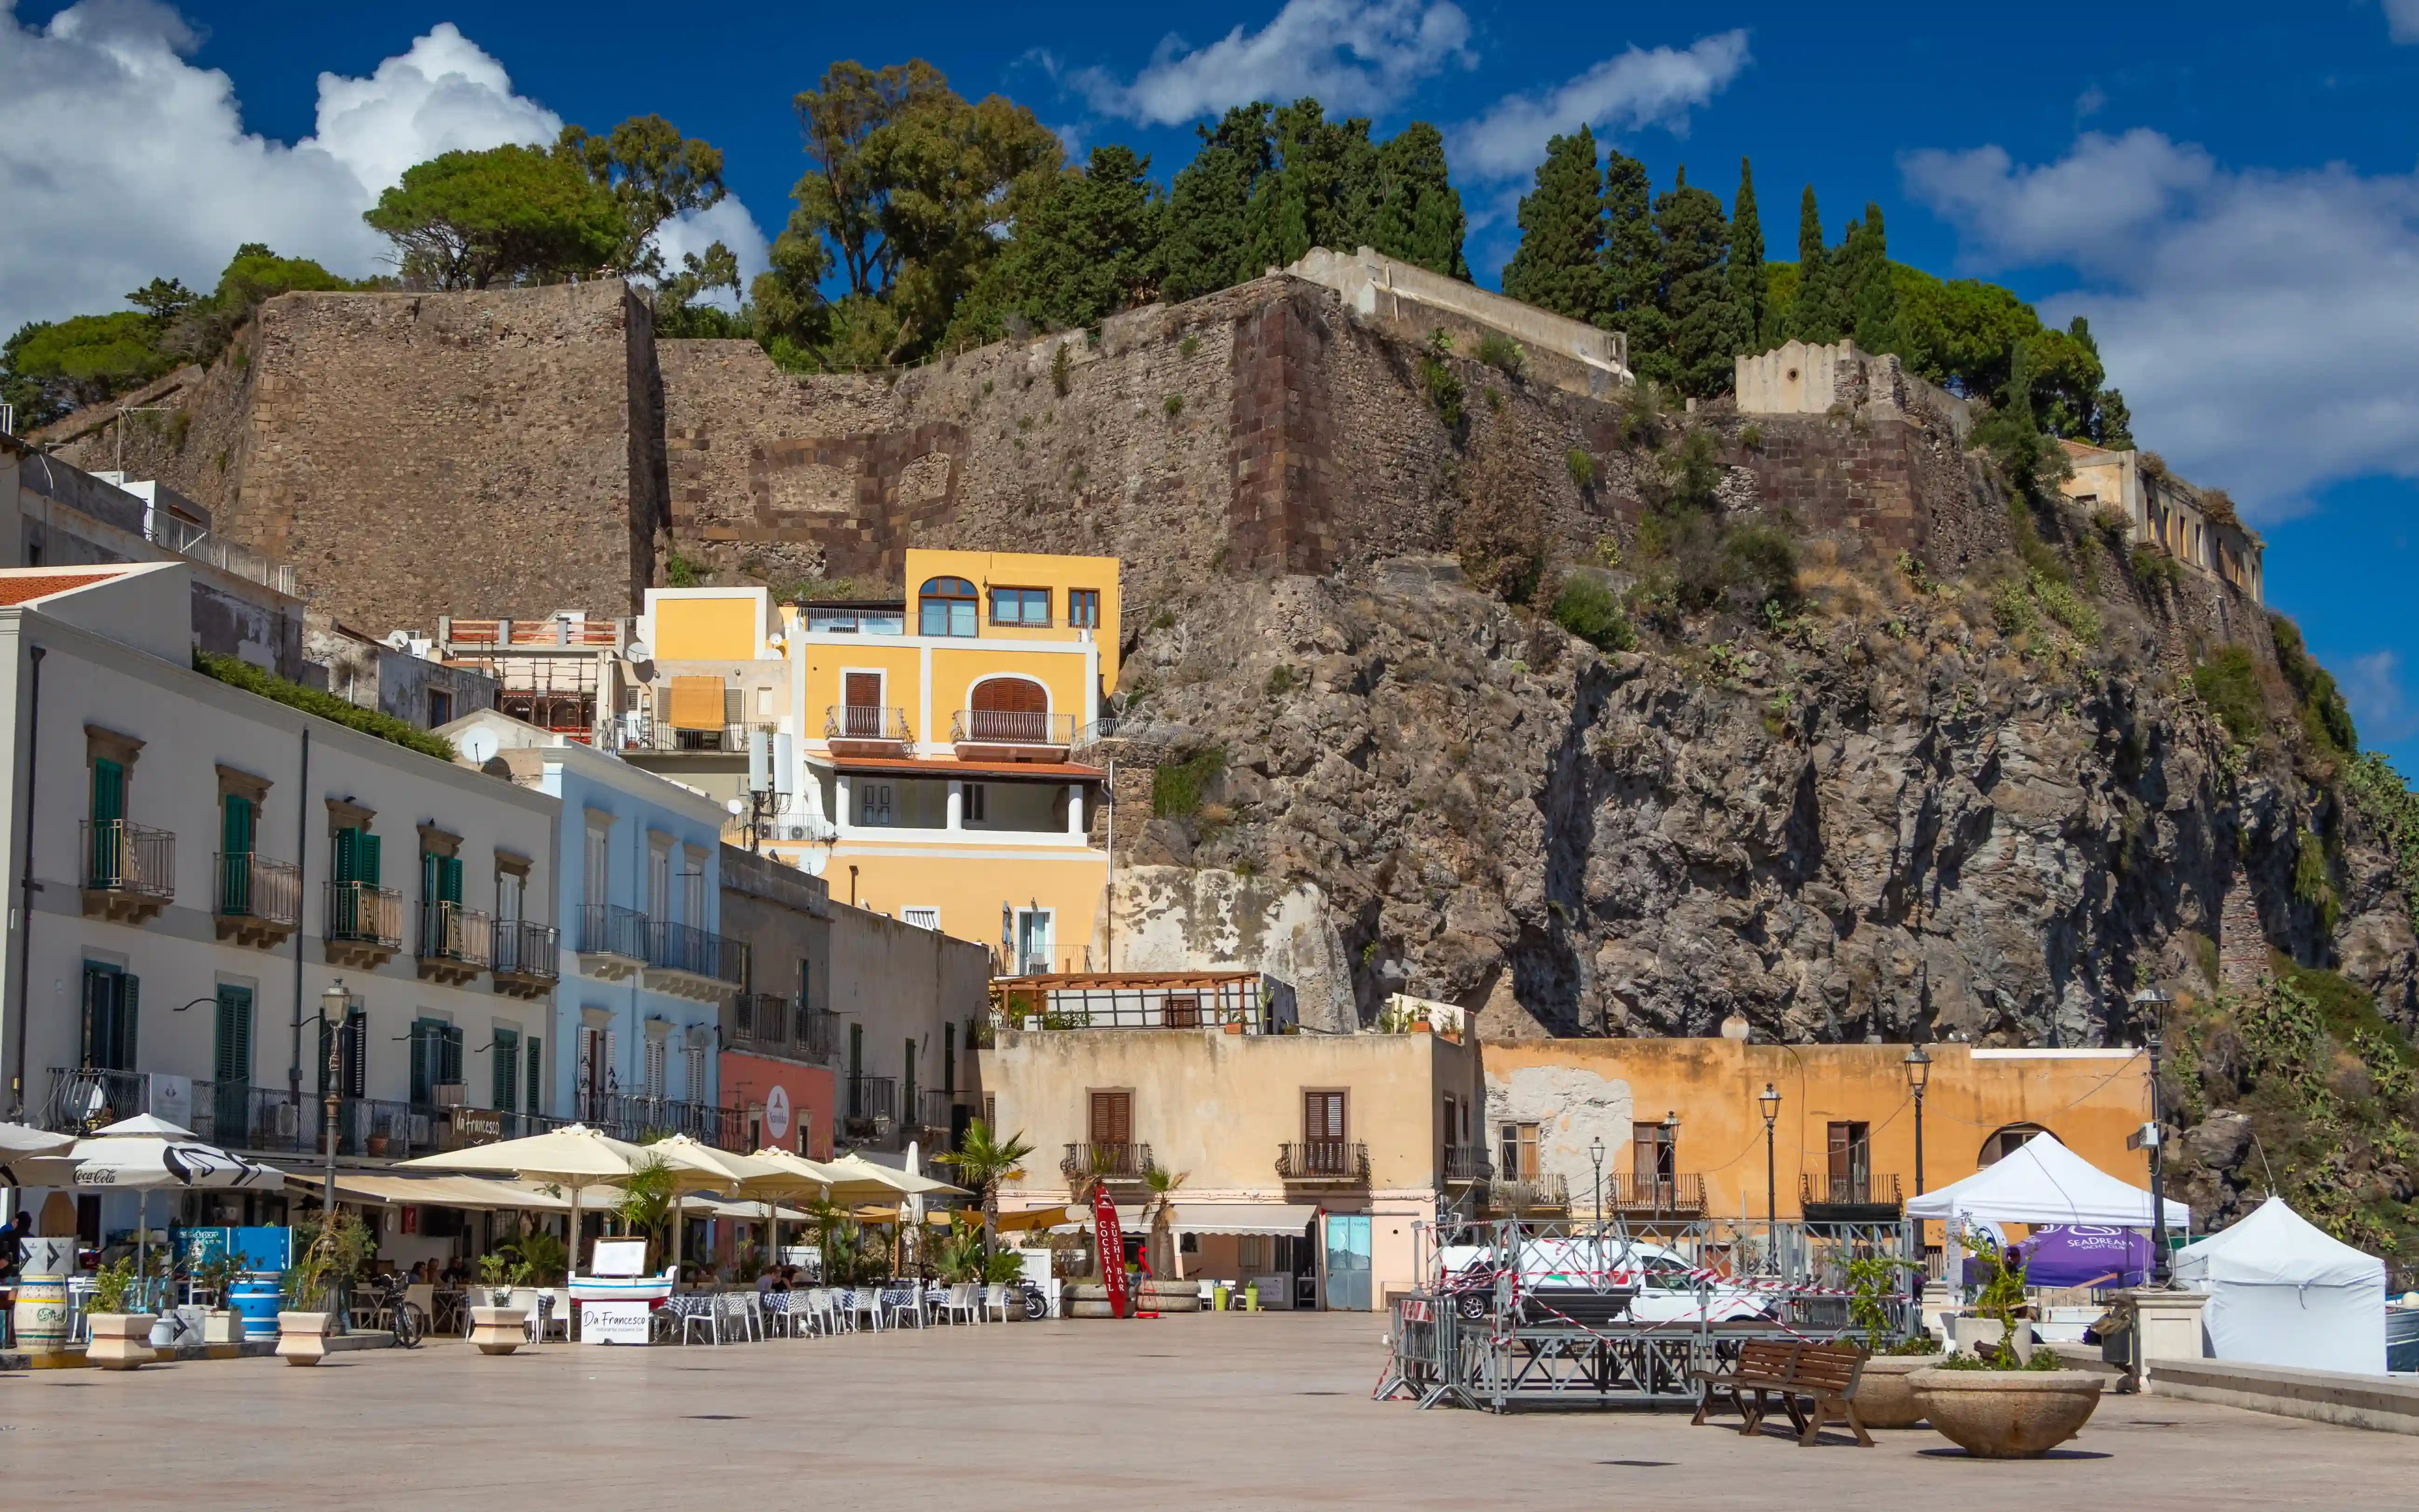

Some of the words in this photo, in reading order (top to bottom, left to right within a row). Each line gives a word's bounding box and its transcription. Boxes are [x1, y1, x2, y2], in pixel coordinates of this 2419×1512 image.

[1100, 1221, 1113, 1291] COCKTAIL
[1111, 1221, 1120, 1261] SUSHI
[583, 1311, 598, 1326] Da
[602, 1311, 645, 1326] Francesco
